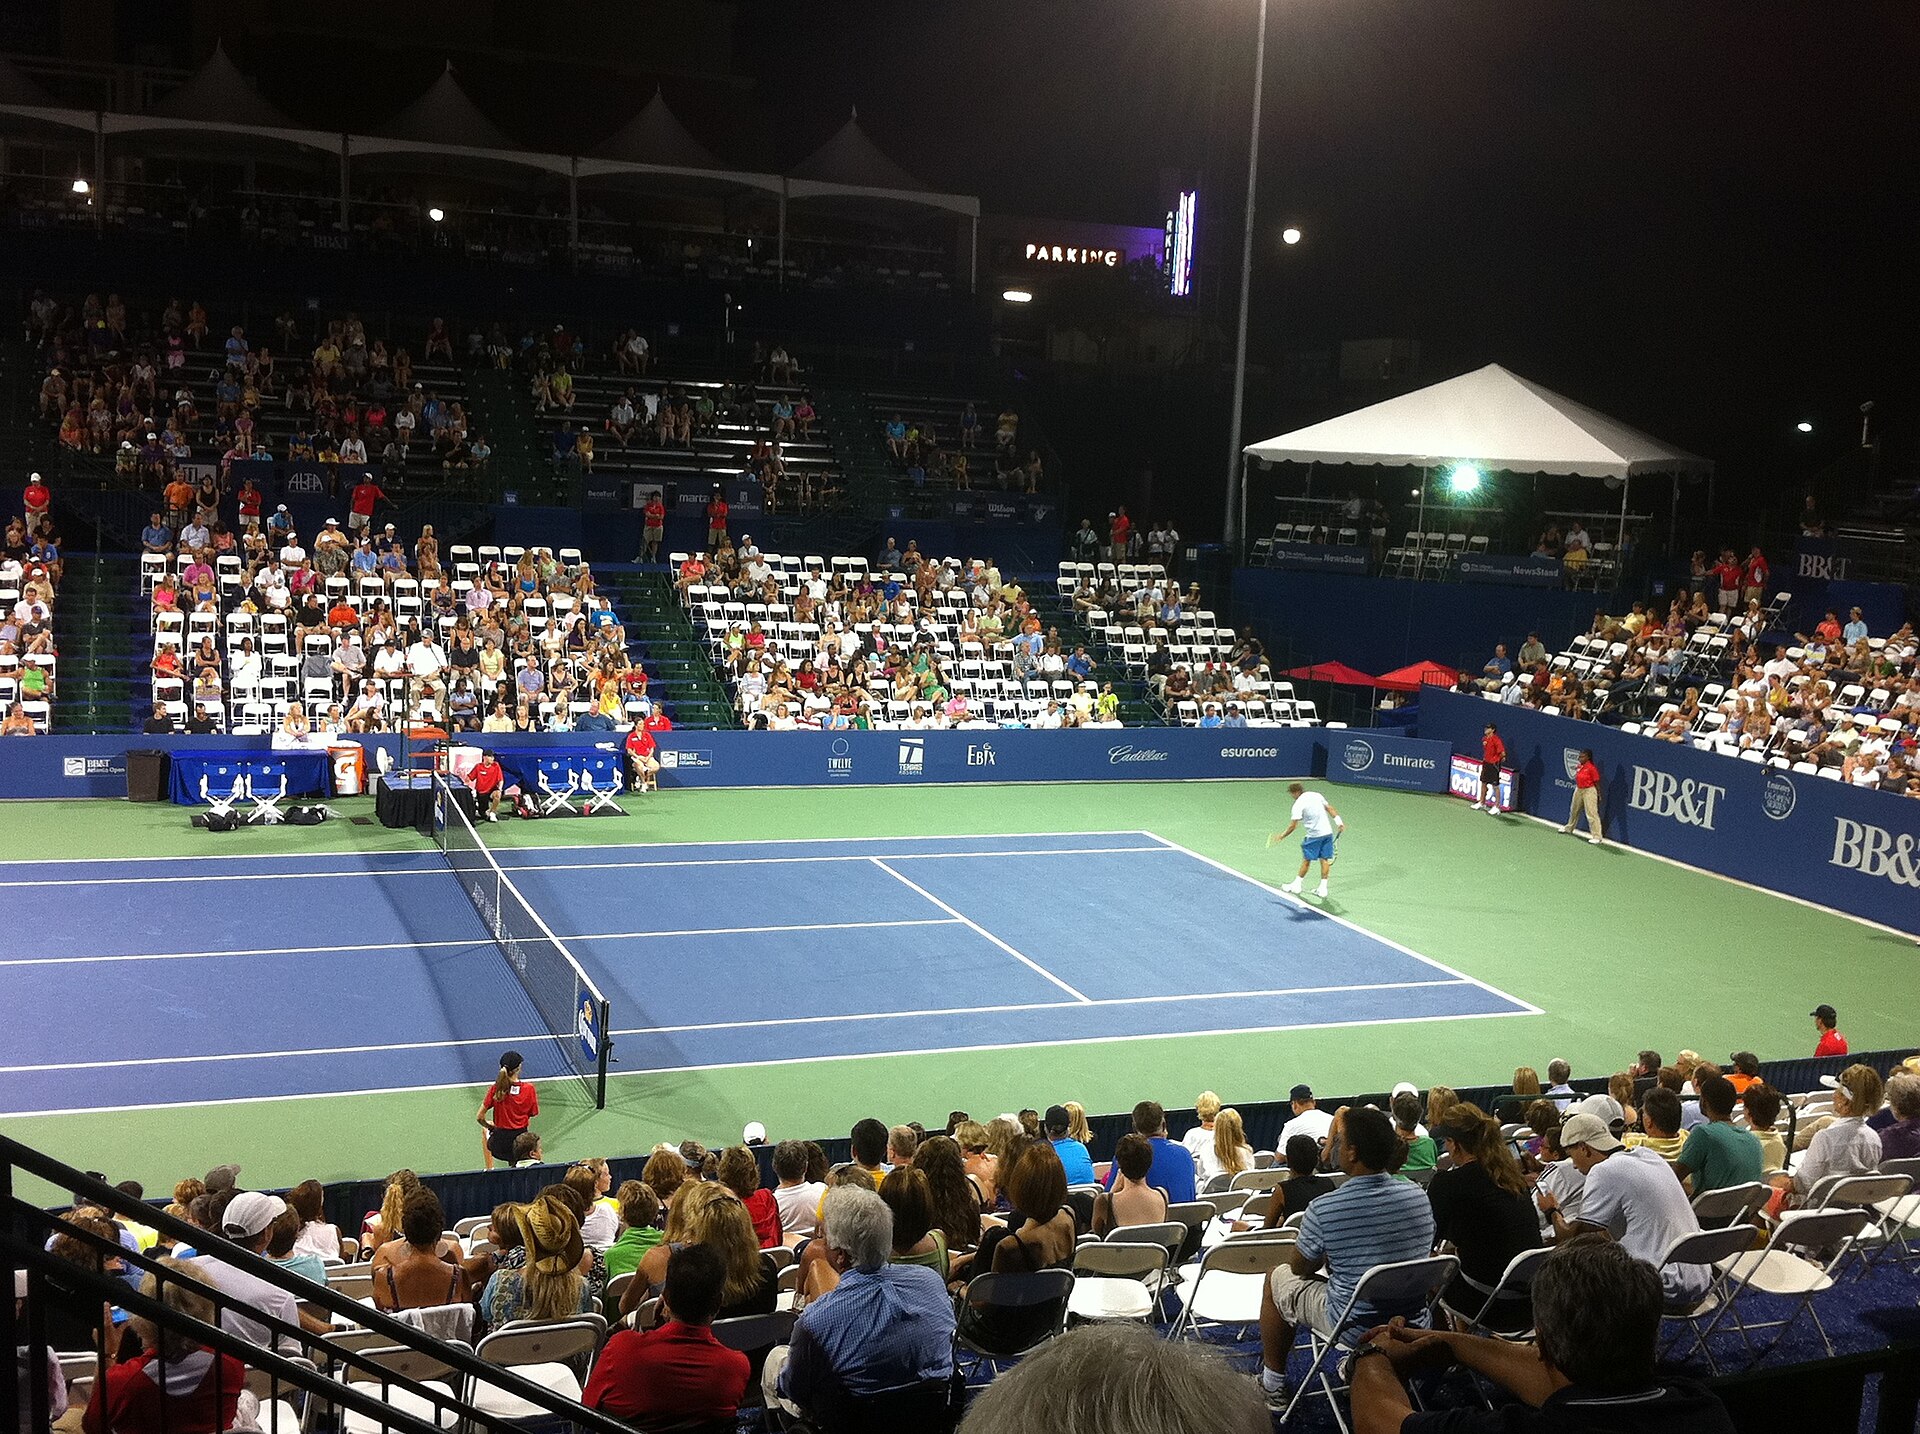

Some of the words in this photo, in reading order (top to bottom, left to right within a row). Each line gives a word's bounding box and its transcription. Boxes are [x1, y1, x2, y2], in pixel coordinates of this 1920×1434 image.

[1026, 243, 1117, 266] PARKING
[1108, 744, 1168, 764] Cadillac
[1220, 747, 1278, 758] esurance
[1383, 753, 1436, 770] Emirates
[1628, 765, 1725, 830] BB&T
[1828, 816, 1920, 888] BB&
